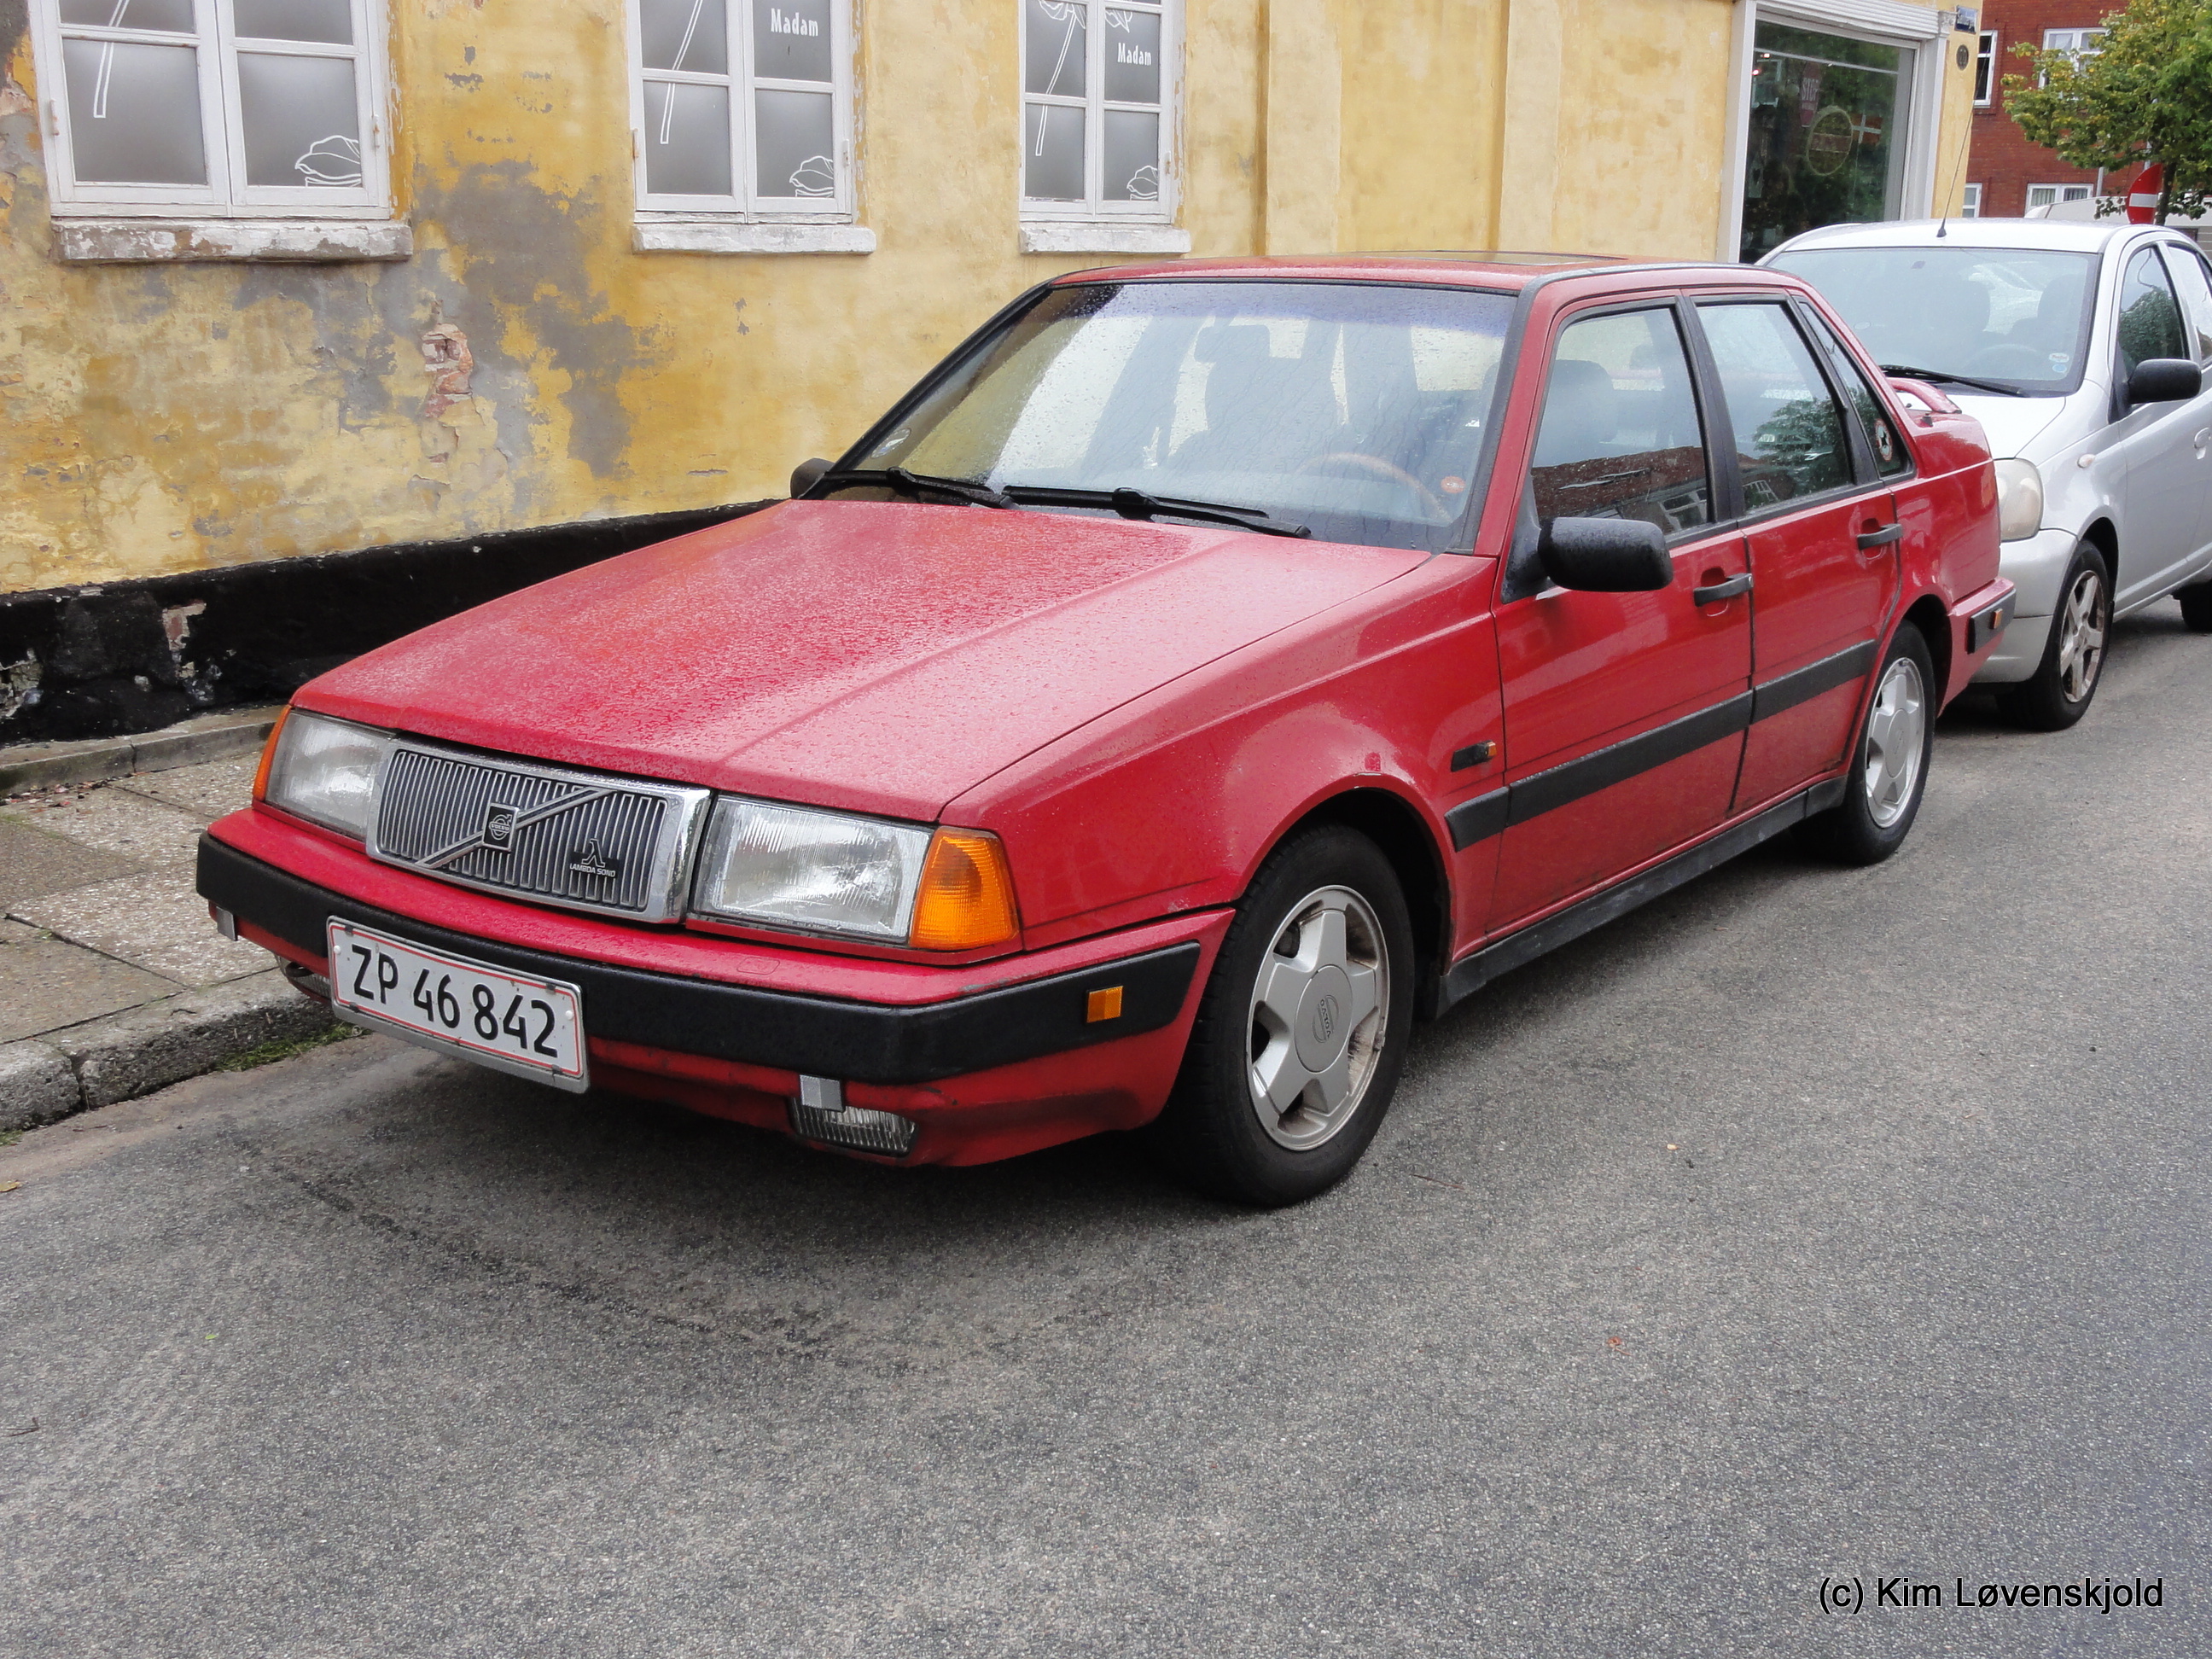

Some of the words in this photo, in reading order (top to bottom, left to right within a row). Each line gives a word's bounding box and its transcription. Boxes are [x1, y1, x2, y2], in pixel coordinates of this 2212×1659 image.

[771, 8, 818, 37] Madam
[1117, 42, 1151, 66] Madam
[569, 862, 597, 874] LAMBDA
[597, 867, 616, 877] SOND
[351, 943, 399, 1004] ZP
[412, 967, 461, 1029] 46
[472, 983, 558, 1058] 842
